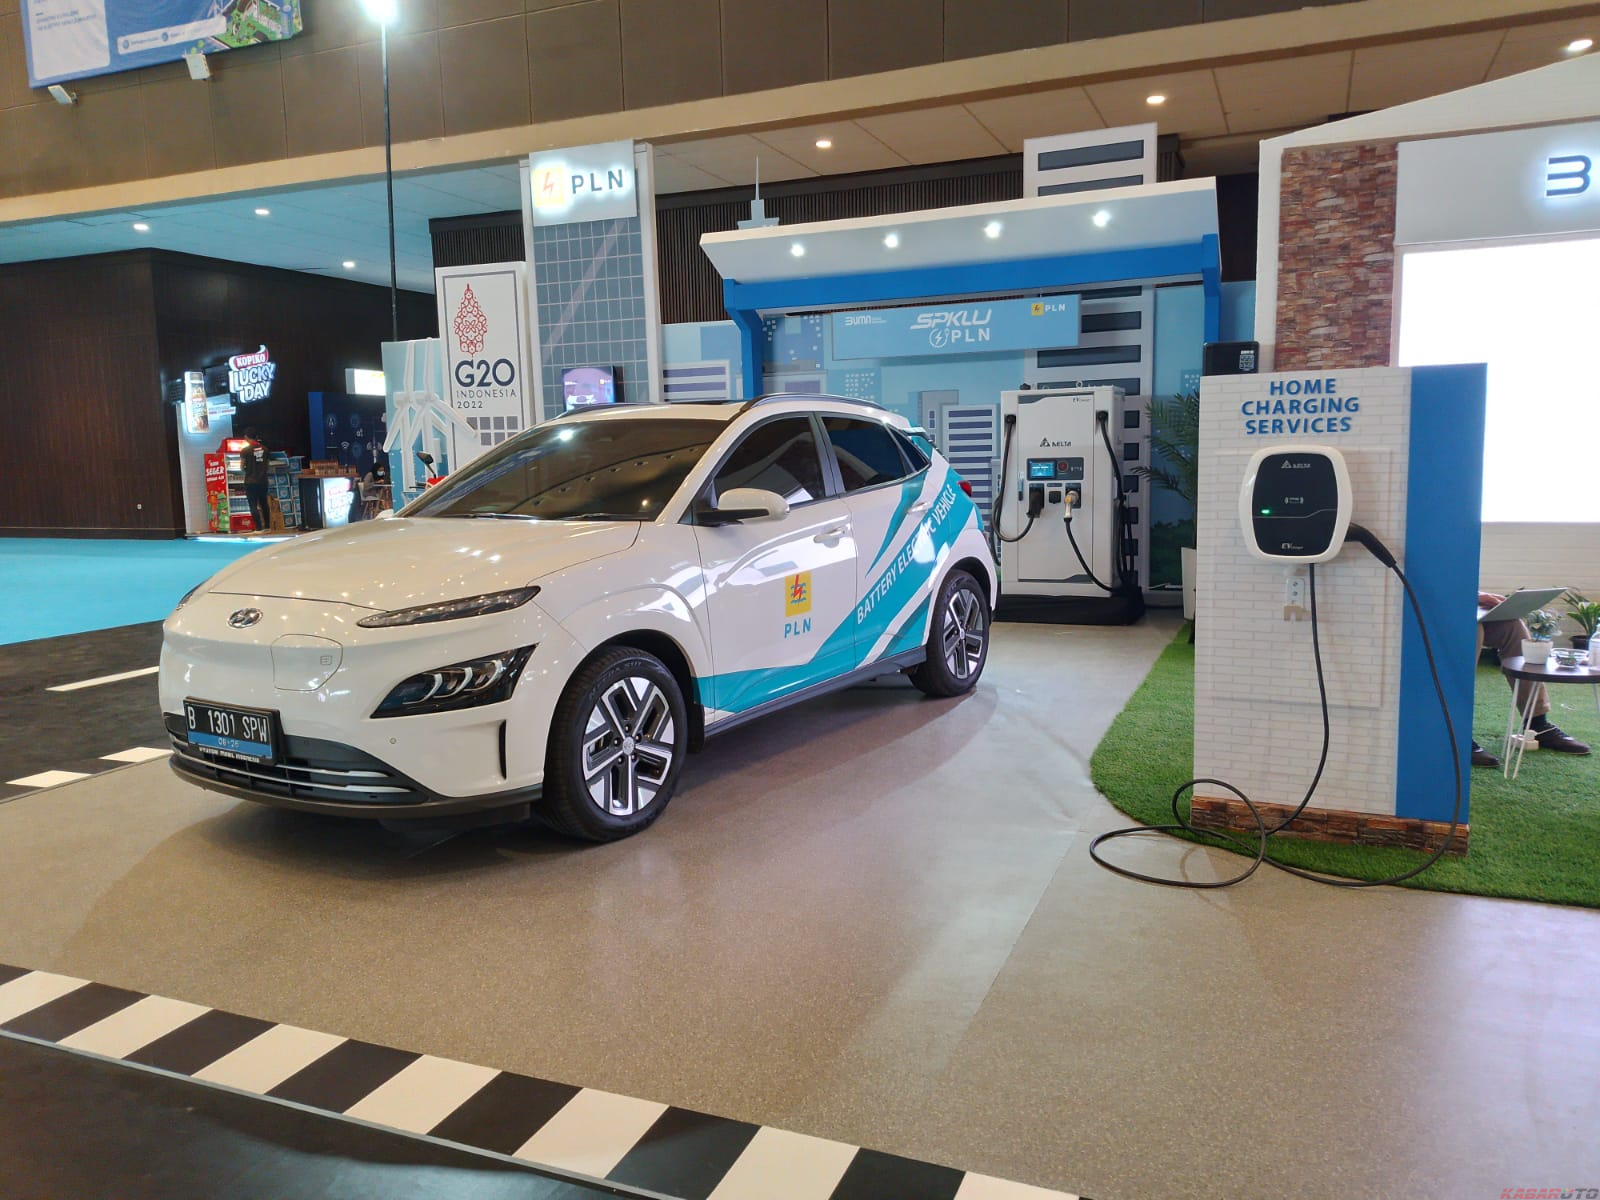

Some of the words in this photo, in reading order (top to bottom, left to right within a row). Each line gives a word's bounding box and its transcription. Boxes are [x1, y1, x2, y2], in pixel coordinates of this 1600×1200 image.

[571, 169, 623, 194] PLN
[1045, 304, 1066, 312] PLN
[910, 309, 993, 330] SPKLU
[951, 328, 990, 343] PLN
[236, 353, 266, 367] KOPIKO
[232, 362, 275, 391] LUCKY
[455, 358, 515, 387] G20
[241, 381, 271, 402] DAY
[456, 389, 517, 399] INDONESIA
[1270, 378, 1336, 396] HOME
[457, 400, 483, 409] 2022
[1241, 397, 1359, 416] CHARGING
[1245, 416, 1352, 435] SERVICES
[857, 569, 898, 624] BATTERY
[898, 517, 936, 575] ELECIC
[931, 484, 957, 526] VEHICLE
[784, 617, 812, 639] PLN
[187, 706, 196, 730] B
[208, 709, 236, 736] 1301
[242, 715, 267, 743] SPW
